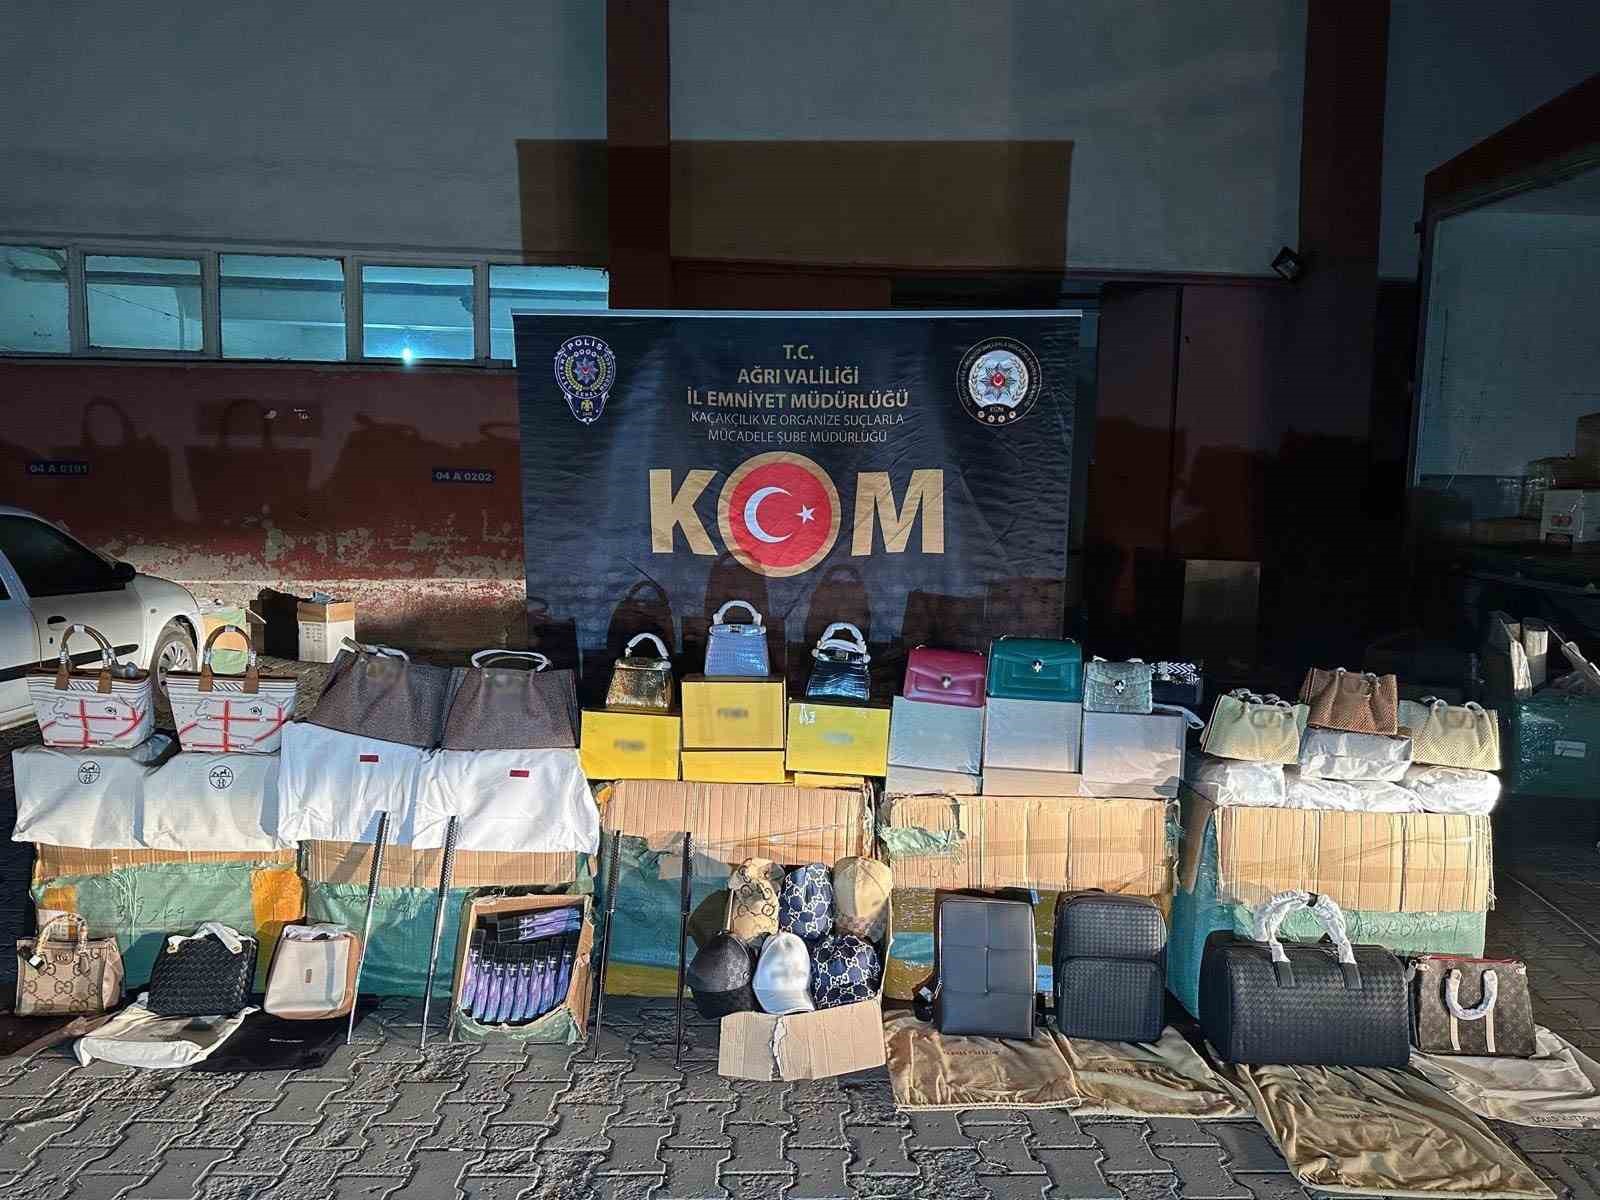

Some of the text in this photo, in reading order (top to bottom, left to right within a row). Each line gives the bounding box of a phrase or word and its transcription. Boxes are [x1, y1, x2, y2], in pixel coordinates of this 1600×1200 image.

[782, 344, 815, 360] T.C.
[737, 364, 859, 385] AĞRI VALİLİĞİ
[687, 386, 909, 409] İL EMNİYET MÜDÜRLÜĞÜ
[691, 410, 905, 429] KAÇAKÇILIK VE ORGANİZE SUÇLARLA
[776, 430, 808, 445] ŞUBE
[47, 463, 58, 474] A
[434, 471, 493, 482] 04 A 0202
